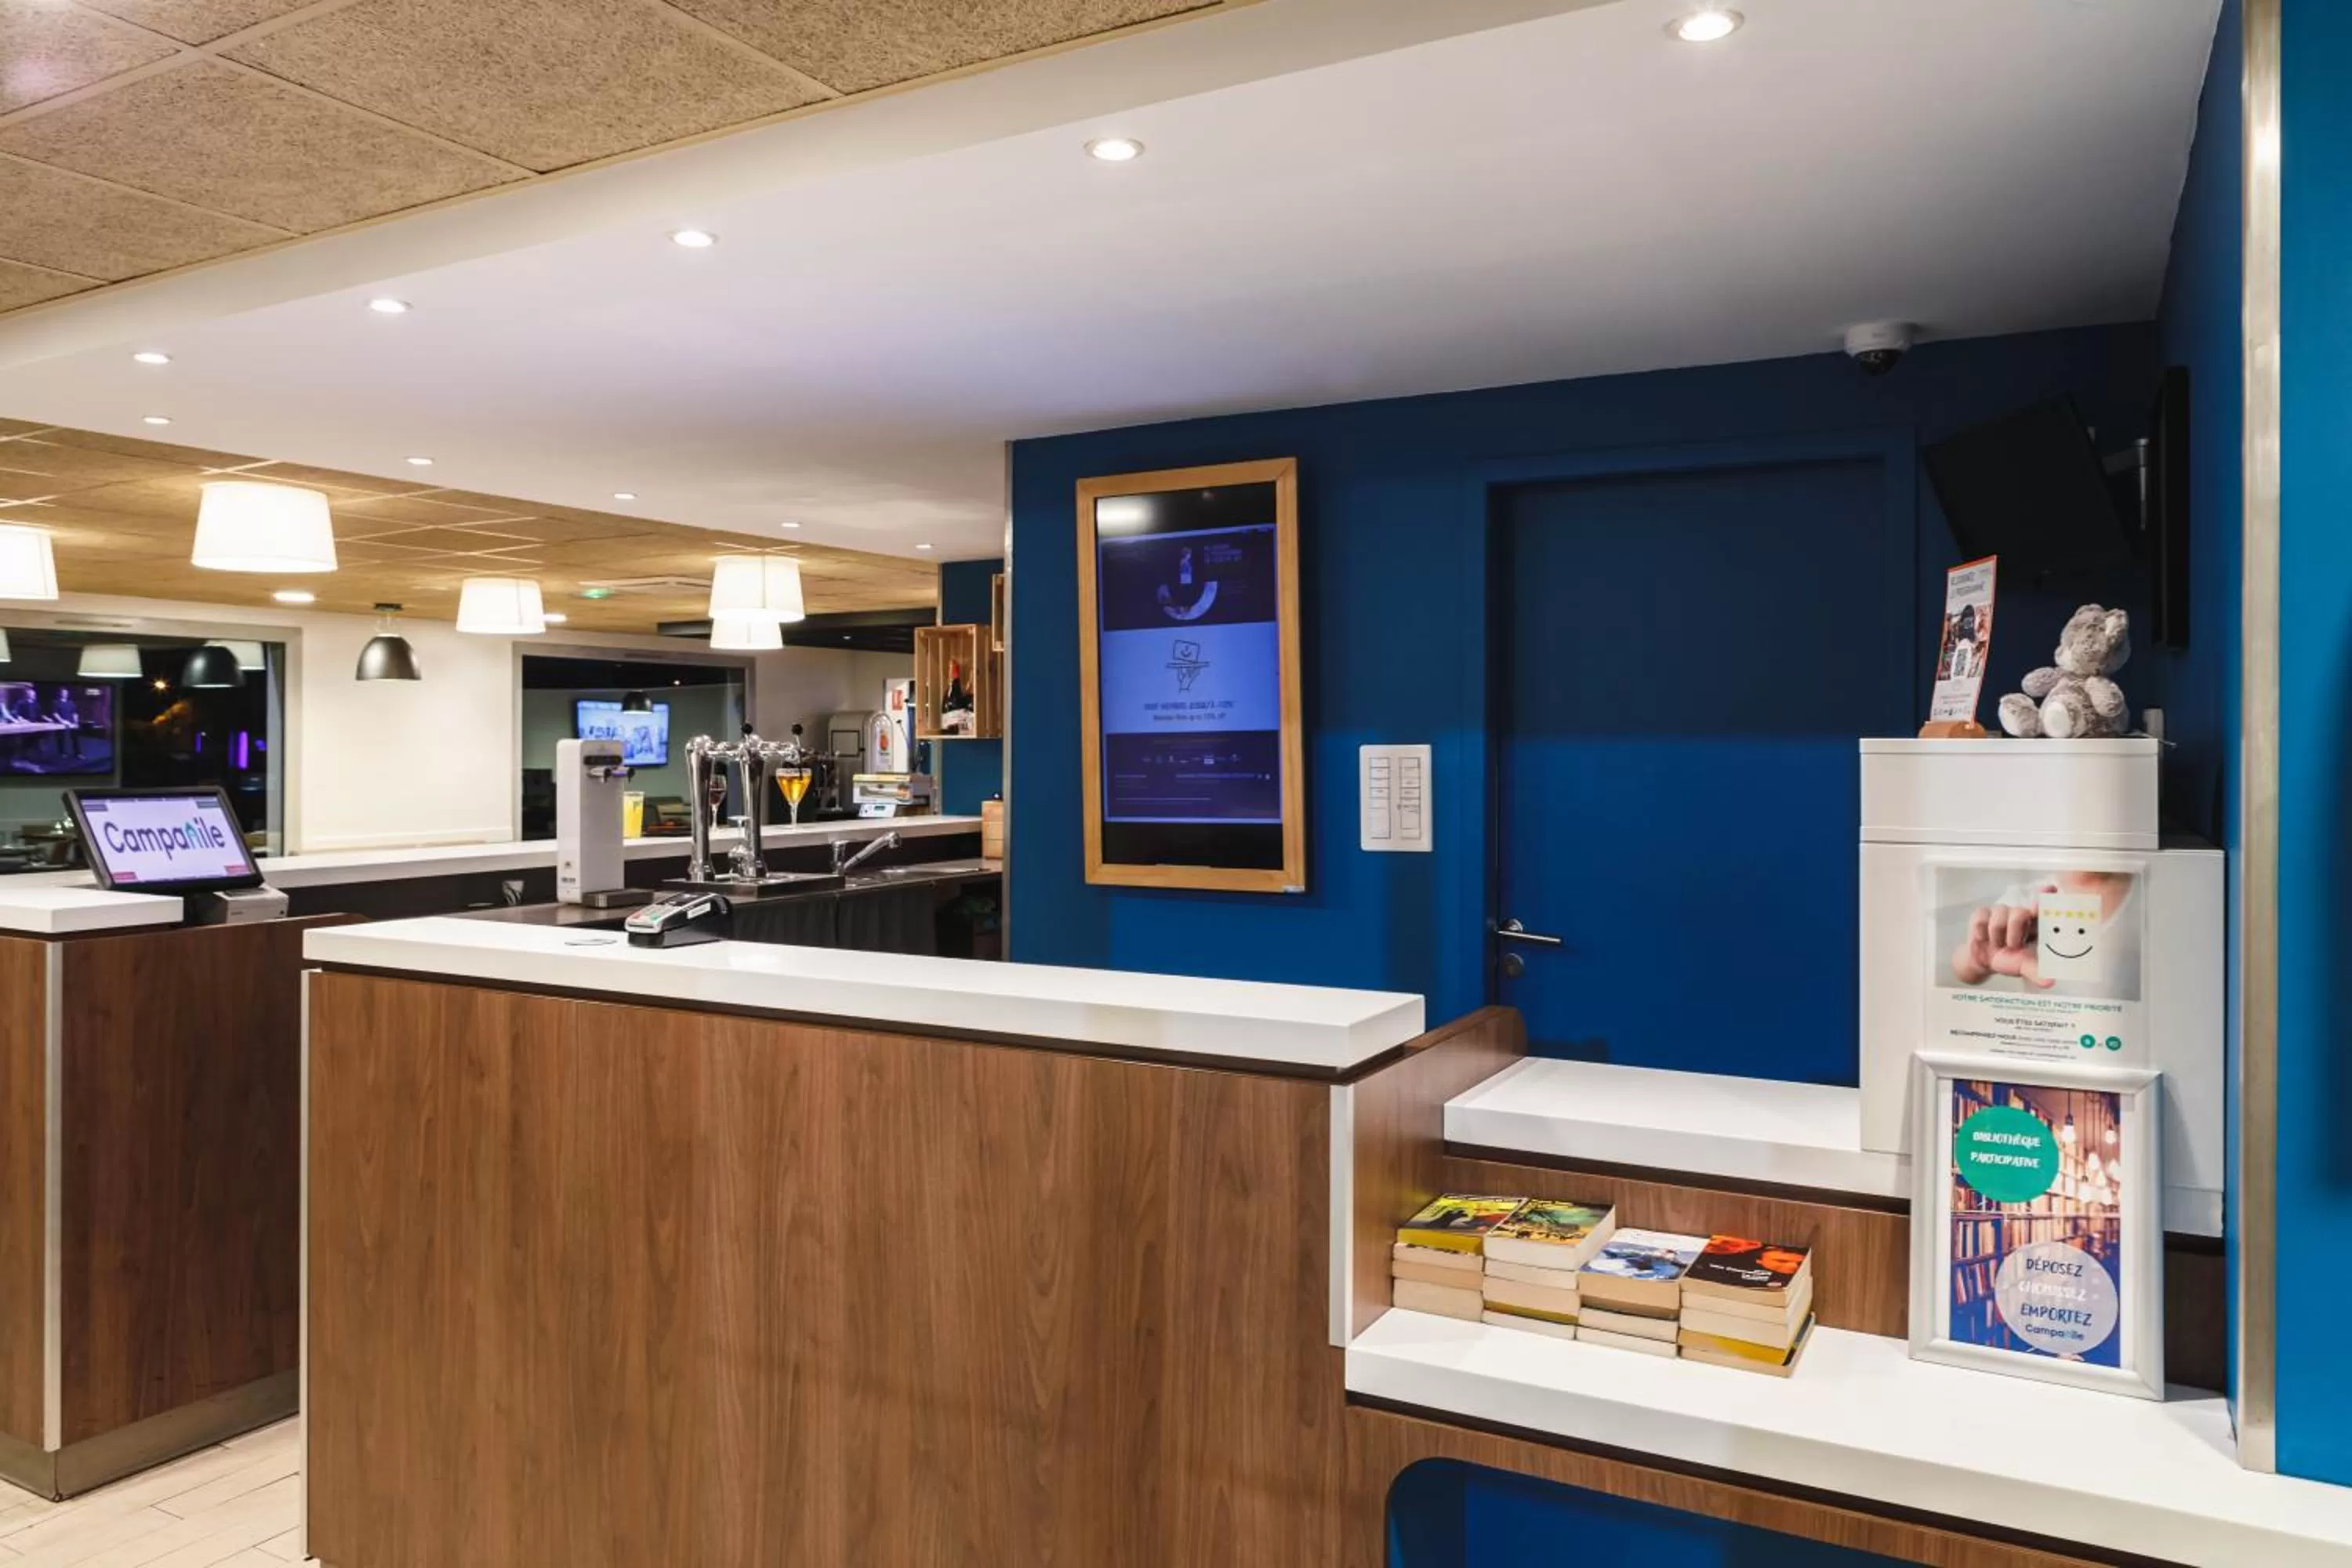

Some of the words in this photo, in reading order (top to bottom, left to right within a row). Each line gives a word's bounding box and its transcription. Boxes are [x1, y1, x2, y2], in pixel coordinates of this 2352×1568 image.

[1969, 1151, 2041, 1168] PARTICIPATIVE
[2026, 1255, 2083, 1277] DÉPOSEZ
[2020, 1302, 2092, 1327] EMPORTEZ
